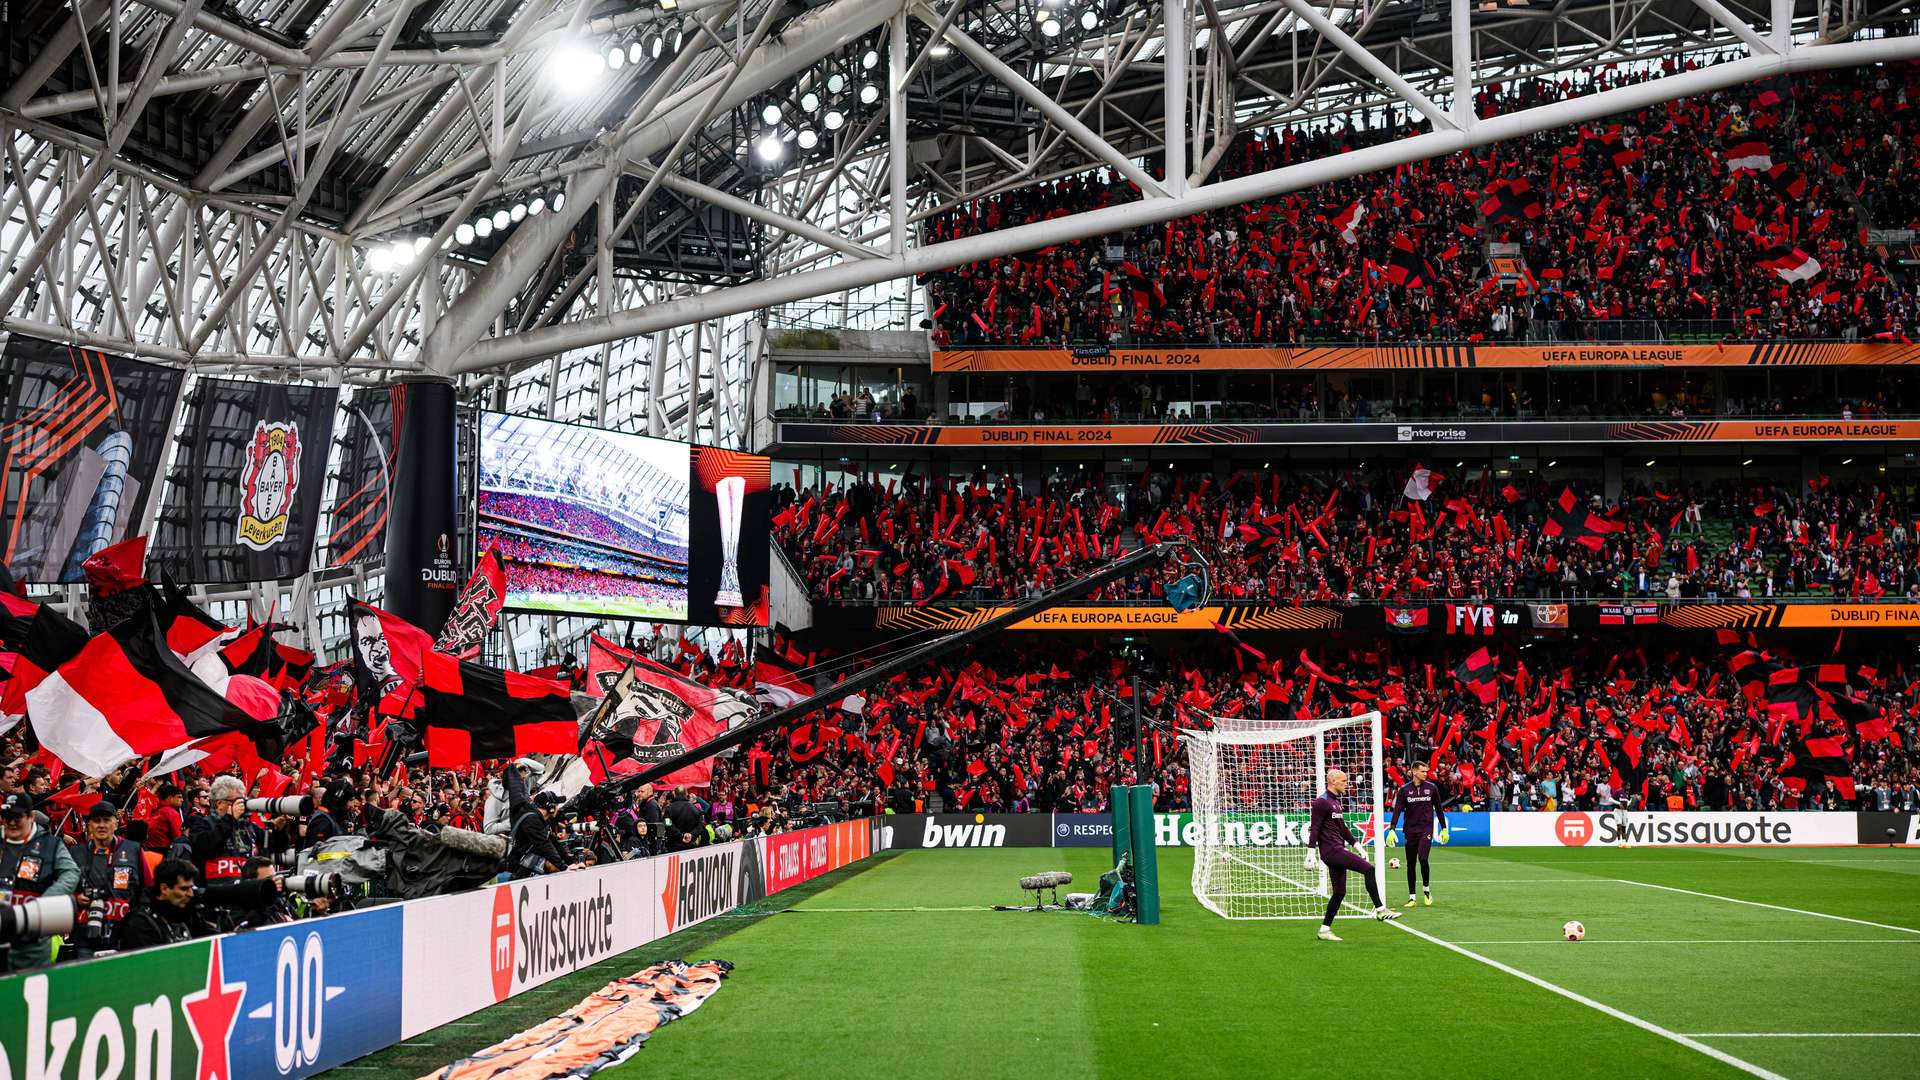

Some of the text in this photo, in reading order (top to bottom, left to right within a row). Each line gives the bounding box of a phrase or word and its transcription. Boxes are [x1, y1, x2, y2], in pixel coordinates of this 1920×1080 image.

[1122, 355, 1161, 365] FINAL
[1166, 354, 1200, 365] 2024
[1542, 351, 1683, 361] UEFA EUROPA LEAGUE
[982, 430, 1112, 442] DUBLIN FINAL 2024
[1399, 427, 1466, 439] enterprise
[1755, 425, 1897, 436] UEFA EUROPA LEAGUE
[271, 432, 284, 447] 1904
[260, 480, 283, 493] BAYER
[264, 456, 278, 518] BAYER
[243, 520, 283, 541] Leverkusen
[421, 568, 457, 583] DUBLIN
[1033, 613, 1178, 623] UEFA EUROPA LEAGUE
[1455, 606, 1494, 628] FVR
[1501, 610, 1519, 625] in
[1830, 609, 1880, 622] DUBLIN
[922, 814, 1006, 848] bwin
[1153, 814, 1318, 847] Heinek
[780, 841, 799, 880] STRAUSS
[518, 879, 613, 984] Swissquote
[275, 931, 323, 1075] 0.0
[0, 974, 173, 1080] ken
